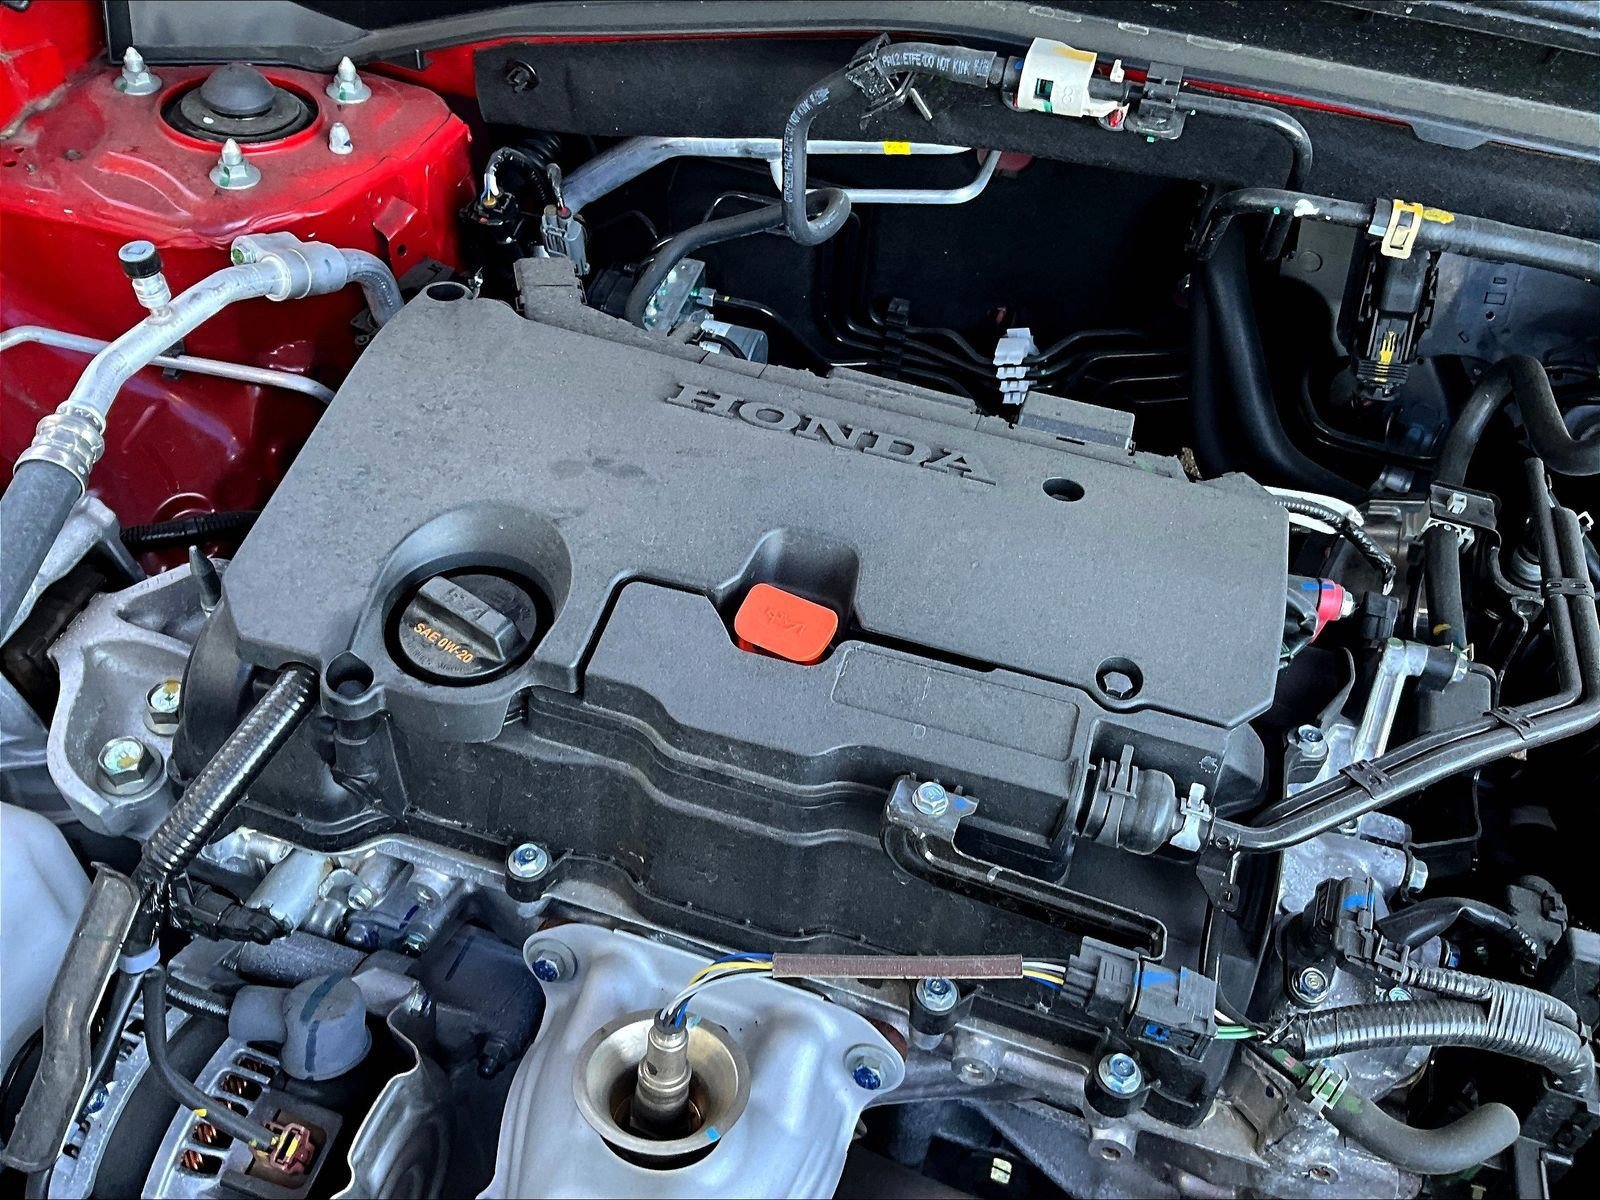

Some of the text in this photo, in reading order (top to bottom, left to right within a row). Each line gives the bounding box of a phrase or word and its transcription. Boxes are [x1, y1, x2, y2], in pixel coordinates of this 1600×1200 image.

[953, 57, 970, 76] KINK
[665, 382, 996, 487] HONDA
[414, 622, 442, 643] SAE
[437, 637, 474, 664] 0W-20
